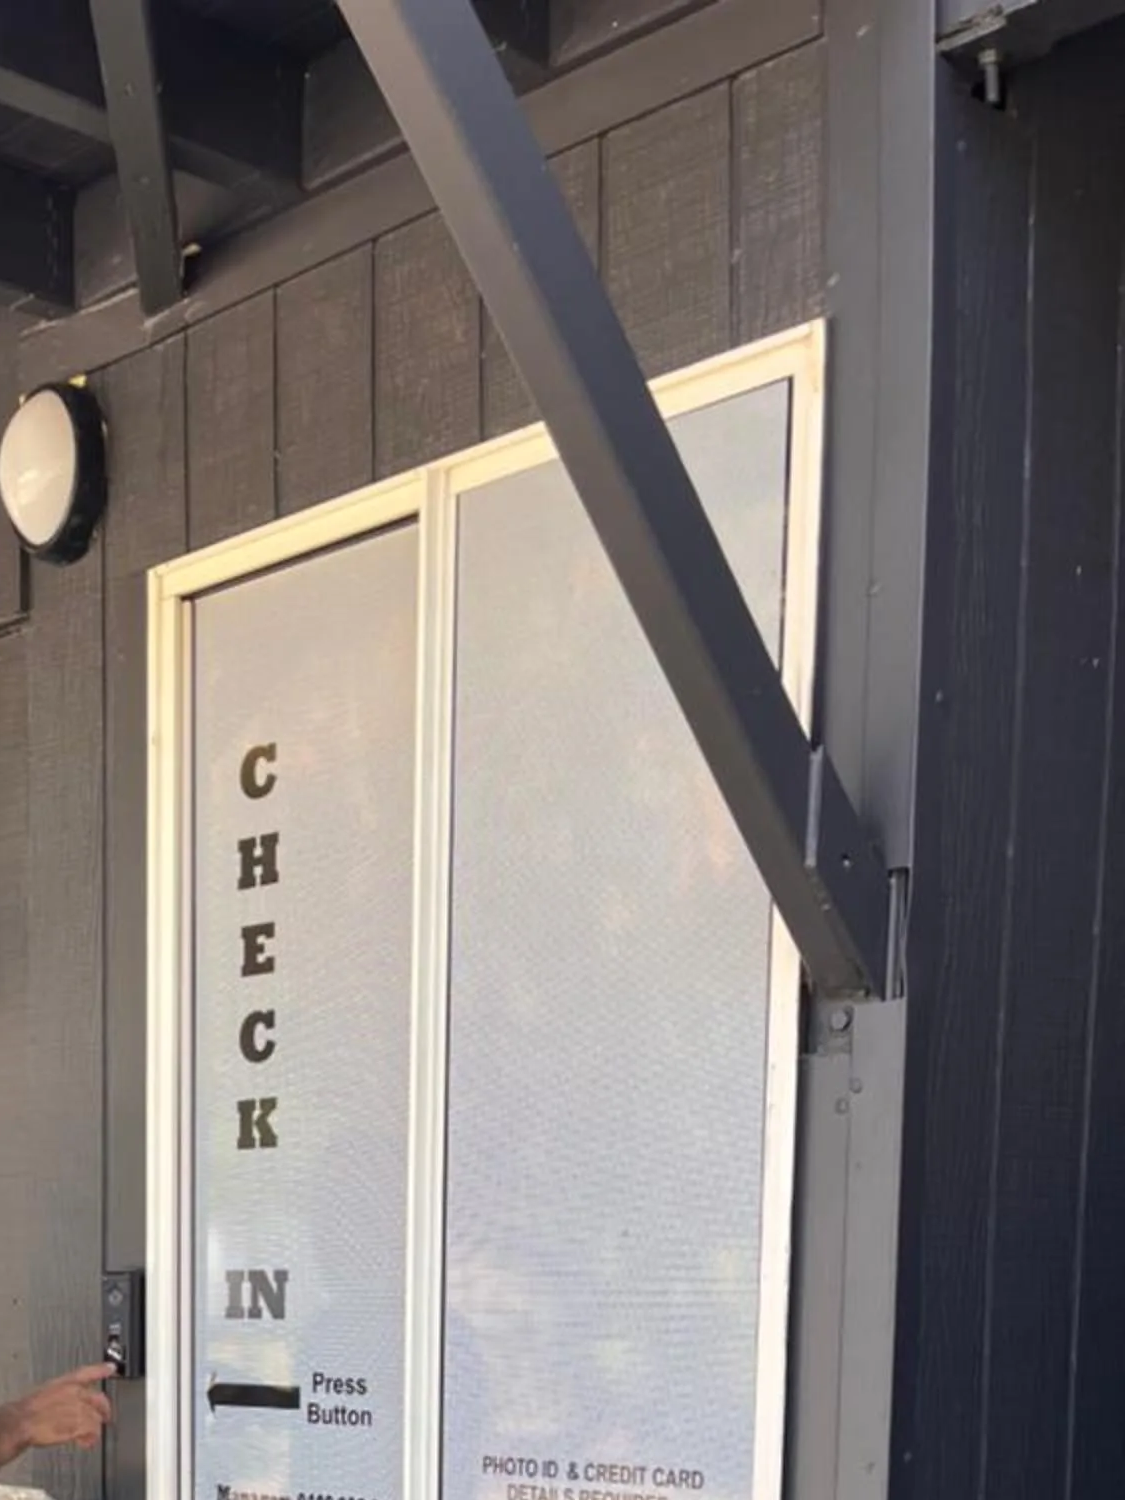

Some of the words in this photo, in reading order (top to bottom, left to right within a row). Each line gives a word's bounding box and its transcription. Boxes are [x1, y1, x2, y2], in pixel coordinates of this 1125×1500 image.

[237, 743, 279, 1150] CHECK
[224, 1269, 289, 1320] IN
[312, 1372, 368, 1395] Press
[307, 1402, 372, 1426] Button
[482, 1455, 538, 1477] PHOTO
[542, 1460, 559, 1479] ID
[567, 1461, 579, 1481] &
[584, 1463, 647, 1486] CREDIT
[652, 1468, 704, 1490] CARD
